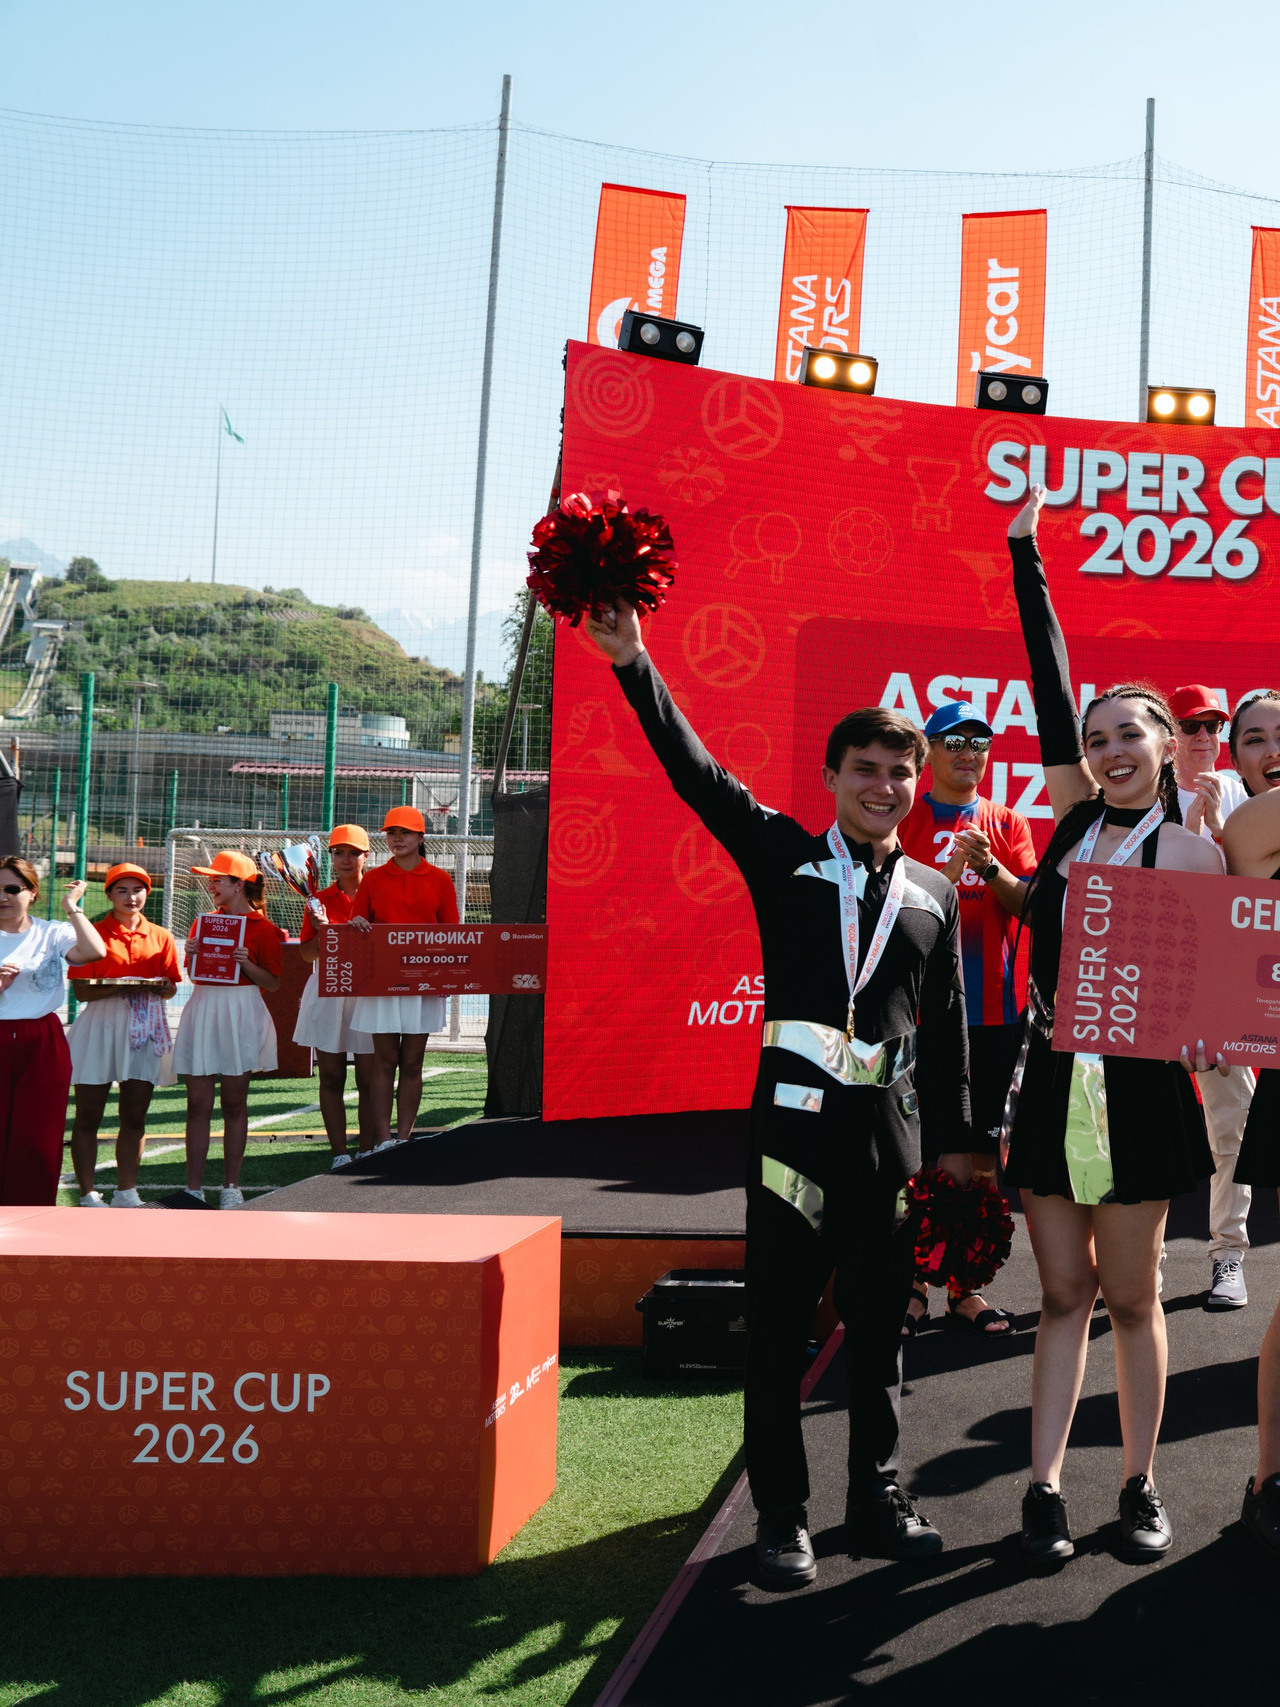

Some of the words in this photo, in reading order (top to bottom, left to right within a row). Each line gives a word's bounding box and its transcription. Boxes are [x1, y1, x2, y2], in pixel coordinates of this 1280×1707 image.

[646, 246, 668, 309] MEGA
[785, 274, 818, 382] STANA
[984, 440, 1209, 514] SUPER
[1078, 512, 1260, 580] 2026
[1123, 832, 1140, 851] 2026
[1138, 822, 1151, 836] CUP
[1082, 875, 1113, 936] CUP
[204, 917, 224, 925] SUPER
[211, 924, 229, 933] 2026
[326, 928, 339, 953] CUP
[387, 931, 484, 945] СЕРТИФИКАТ
[870, 933, 884, 959] SUPER
[402, 955, 407, 964] 1
[409, 955, 431, 964] 200
[432, 955, 455, 963] 000
[325, 956, 339, 993] SUPER
[340, 961, 353, 993] 2026
[1072, 946, 1108, 1042] SUPER
[1107, 964, 1141, 1045] 2026
[687, 1000, 765, 1026] MOT
[1222, 1040, 1278, 1055] MOTORS
[1240, 1033, 1278, 1044] ASTANA
[64, 1370, 217, 1412] SUPER
[233, 1372, 331, 1413] CUP
[133, 1423, 259, 1464] 2026
